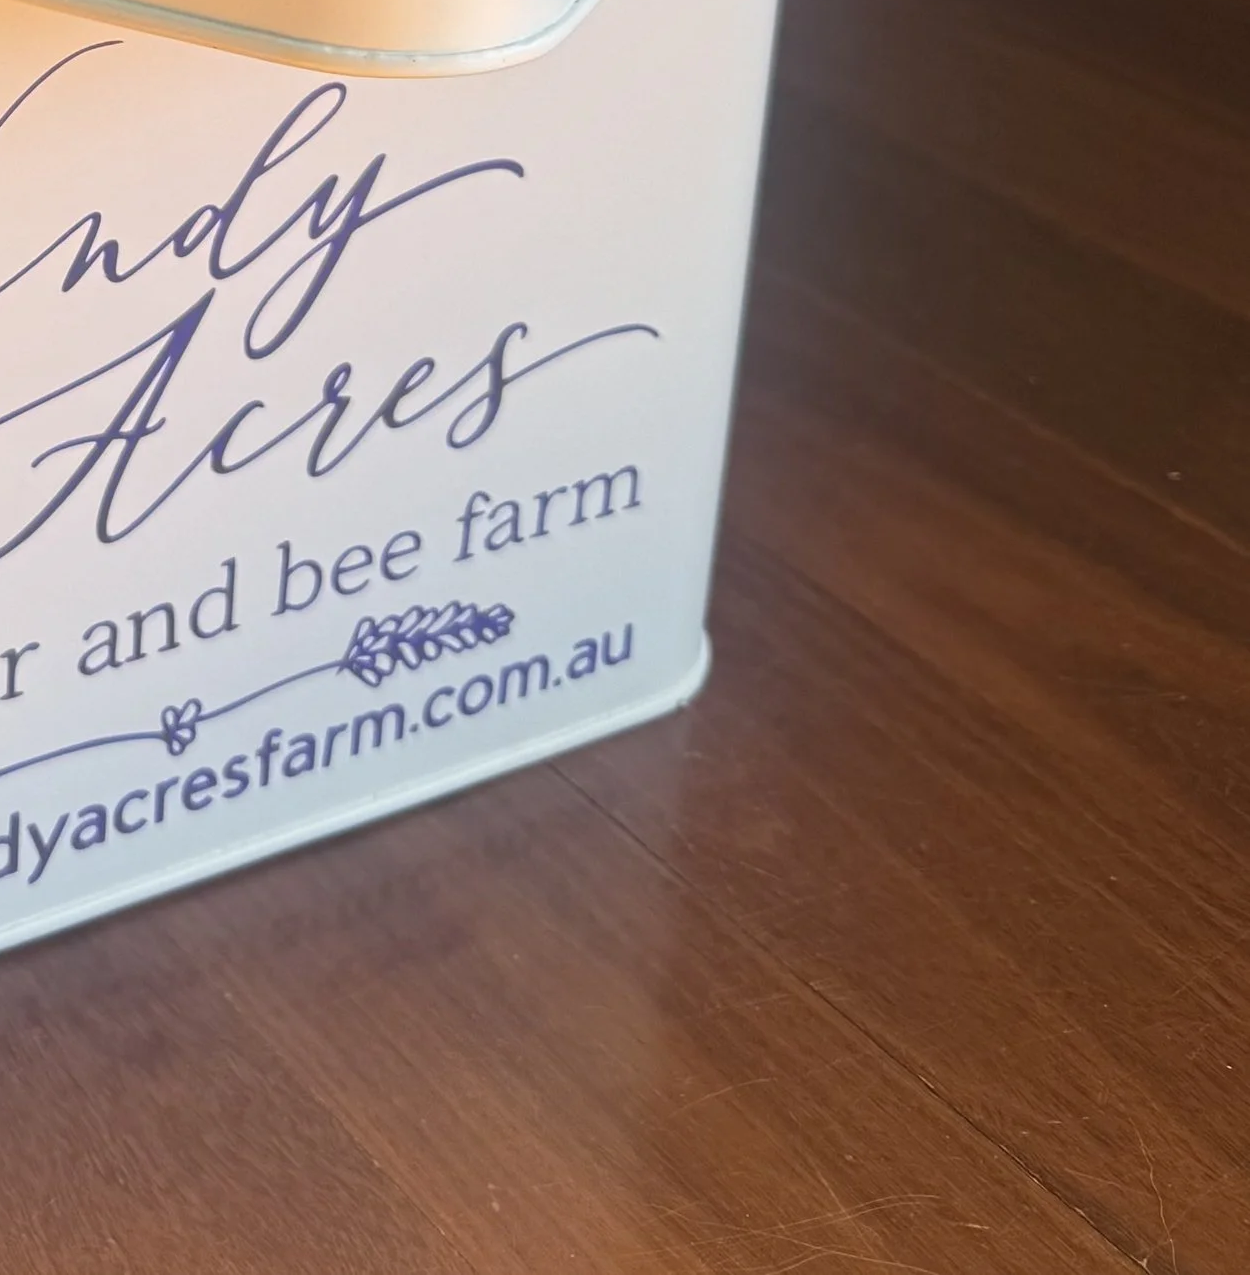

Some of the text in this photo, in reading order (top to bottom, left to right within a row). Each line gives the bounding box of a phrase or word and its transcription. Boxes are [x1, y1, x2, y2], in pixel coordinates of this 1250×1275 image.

[75, 557, 242, 683] and
[273, 522, 425, 621] bee
[450, 457, 645, 566] farm
